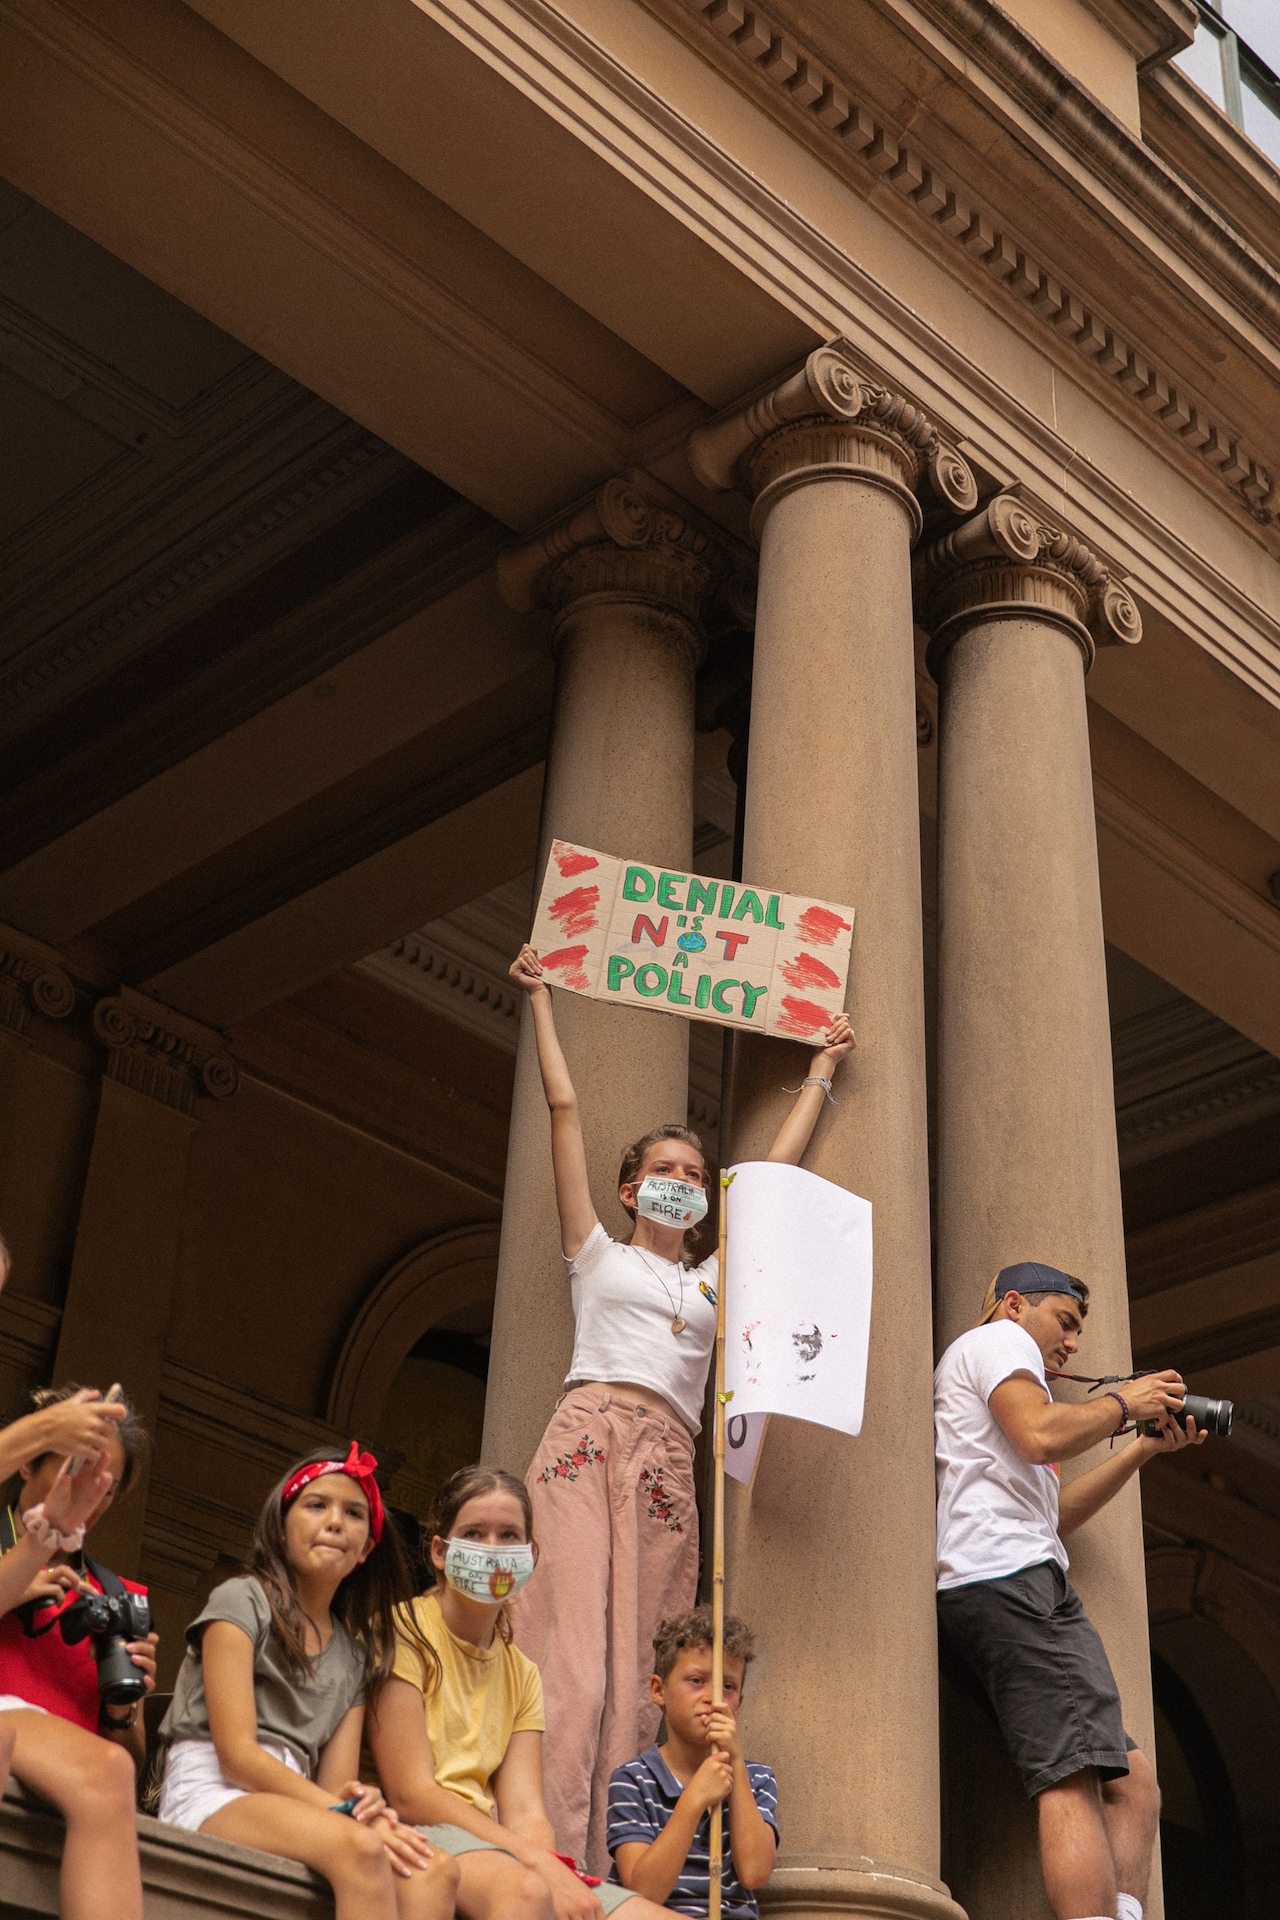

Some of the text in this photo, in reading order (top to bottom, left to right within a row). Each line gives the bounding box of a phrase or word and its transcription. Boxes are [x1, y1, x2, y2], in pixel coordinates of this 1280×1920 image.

[622, 866, 785, 930] DENIAL
[677, 915, 703, 931] IS
[672, 952, 689, 968] A
[607, 955, 768, 1018] POLICY
[647, 1181, 695, 1197] AUSTRALIA
[652, 1202, 683, 1220] FIRE
[453, 1551, 517, 1570] AUSTRALIA
[452, 1567, 482, 1580] IS ON
[453, 1577, 475, 1594] FIRE
